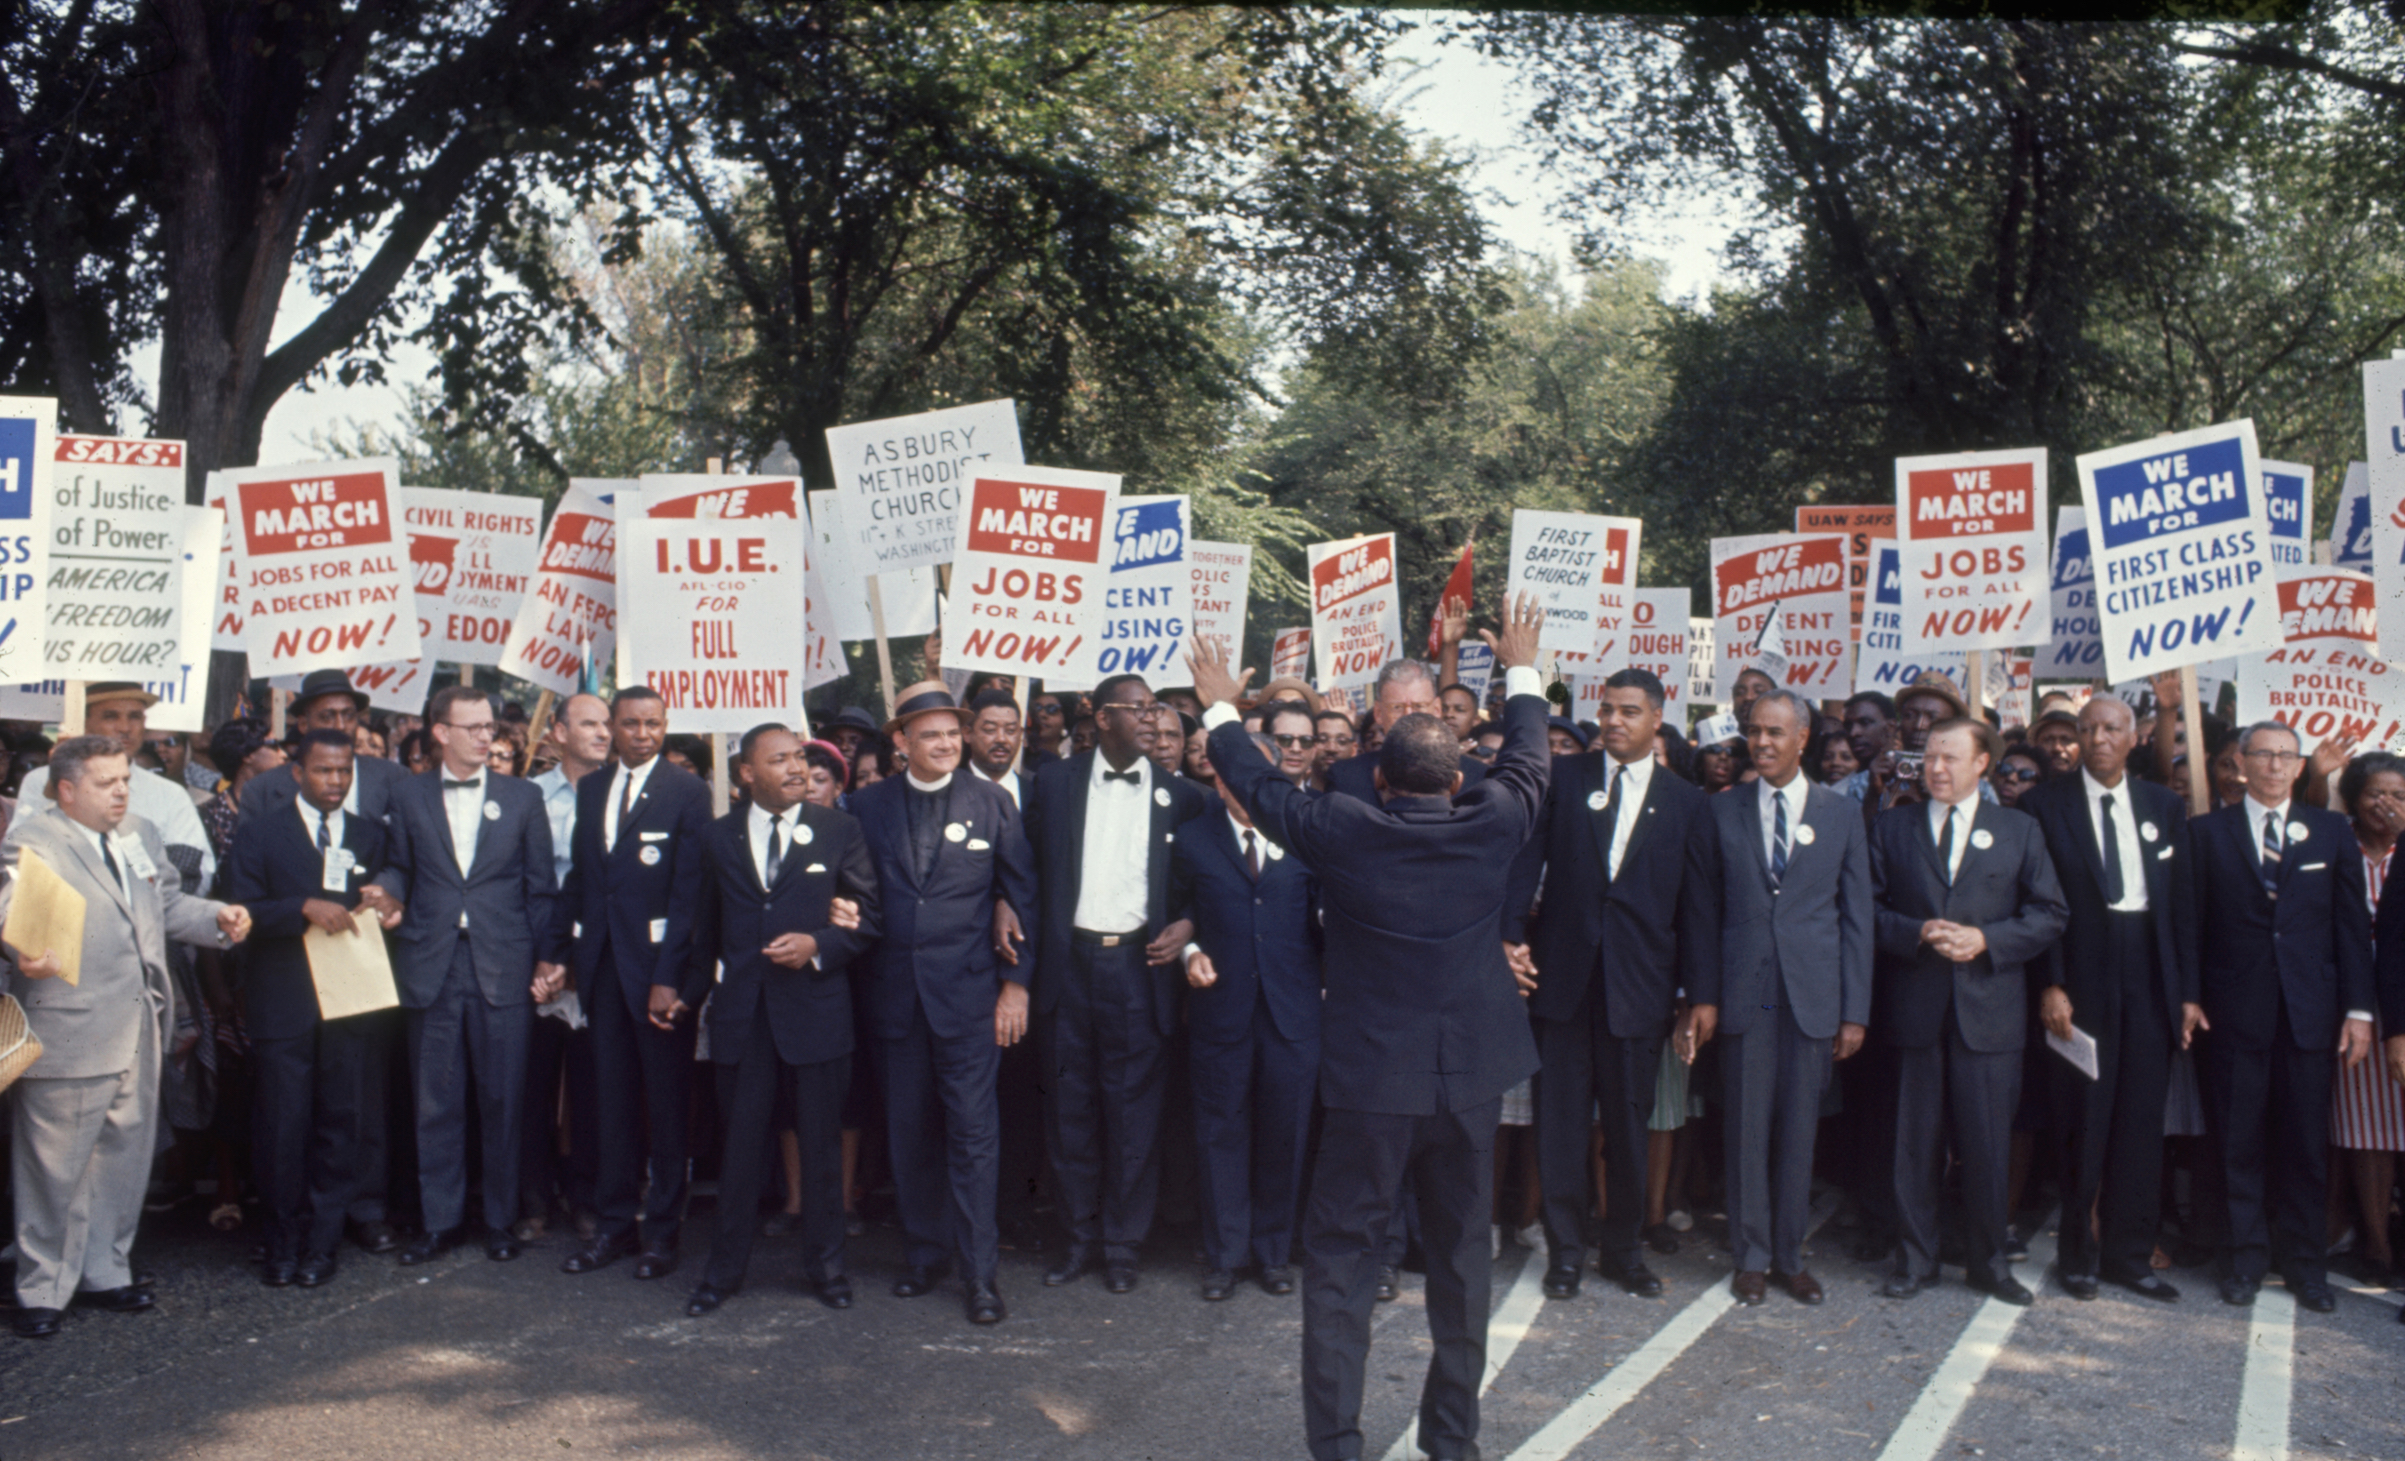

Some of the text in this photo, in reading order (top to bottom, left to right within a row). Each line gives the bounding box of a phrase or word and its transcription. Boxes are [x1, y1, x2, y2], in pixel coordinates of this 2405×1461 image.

[66, 440, 178, 466] SAYS:
[864, 426, 976, 465] ASBURY
[1953, 470, 1991, 491] WE
[2142, 454, 2189, 484] WE
[56, 475, 84, 507] of
[291, 480, 336, 504] WE
[693, 489, 750, 518] WE
[1018, 487, 1058, 510] WE
[1918, 489, 2026, 521] MARCH
[2110, 471, 2236, 526] MARCH
[56, 517, 85, 546] of
[255, 499, 380, 536] MARCH
[405, 507, 535, 536] CIVIL RIGHTS
[978, 508, 1093, 542] MARCH
[1808, 514, 1895, 526] UAW SAYS
[1953, 519, 1994, 534] FOR
[2148, 511, 2199, 535] FOR
[296, 531, 345, 549] FOR
[581, 518, 616, 548] WE
[1010, 539, 1055, 555] FOR
[1538, 527, 1592, 546] FIRST
[656, 538, 779, 574] I.U.E.
[1339, 546, 1370, 575] WE
[1525, 546, 1597, 567] BAPTIST
[1755, 545, 1803, 575] WE
[1920, 545, 2026, 580] JOBS
[2107, 530, 2256, 585] FIRST CLASS
[47, 567, 170, 593] AMERICA
[248, 566, 304, 587] JOBS
[310, 560, 353, 580] FOR
[360, 556, 398, 575] ALL
[972, 567, 1083, 605] JOBS
[1320, 556, 1390, 607] DEMAND
[1523, 565, 1591, 587] CHURCH
[1725, 562, 1841, 609] DEMAND
[251, 584, 400, 616] A DECENT PAY
[536, 578, 569, 607] AN
[1925, 581, 2024, 599] FOR ALL
[2106, 560, 2263, 615] CITIZENSHIP
[2296, 578, 2357, 608] WE
[51, 603, 173, 629] FREEDOM
[696, 596, 739, 612] FOR
[972, 603, 1076, 625] FOR ALL
[1327, 600, 1386, 622] AN END
[545, 612, 597, 646] LAW
[1342, 621, 1378, 638] POLICE
[1737, 612, 1834, 632] DEENT
[1922, 599, 2032, 639] NOW!
[2128, 596, 2256, 662] NOW!
[273, 613, 396, 659] NOW!
[692, 620, 738, 660] FULL
[962, 628, 1082, 666] NOW!
[1331, 633, 1385, 653] BRUTALITY
[79, 639, 177, 668] HOUR?
[1332, 640, 1394, 677] NOW!
[2265, 648, 2388, 675] AN END
[2292, 674, 2367, 697] POLICE
[2269, 691, 2382, 717] BRUTALITY
[2273, 709, 2400, 750] NOW!
